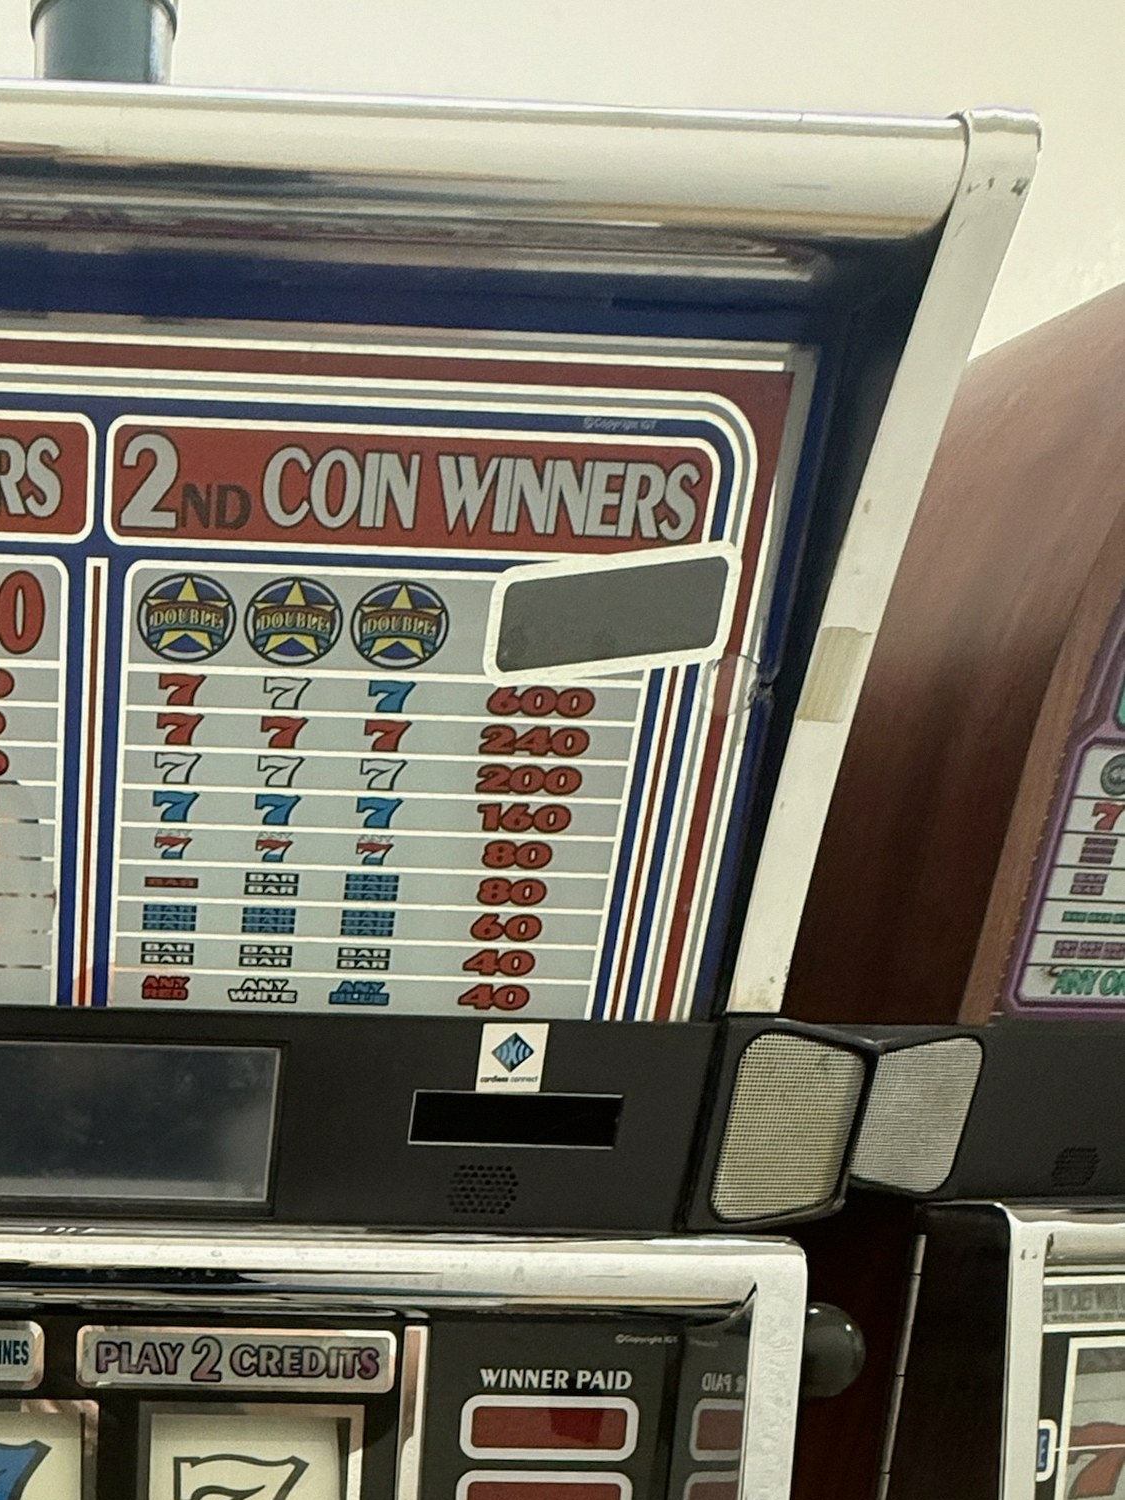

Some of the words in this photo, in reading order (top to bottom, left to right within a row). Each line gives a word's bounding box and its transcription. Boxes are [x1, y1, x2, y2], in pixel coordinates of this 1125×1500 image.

[261, 444, 421, 531] COIN
[436, 453, 701, 541] WINNERS
[153, 608, 222, 631] DOUBLE
[259, 611, 330, 633] DOUBLE
[364, 613, 435, 637] DOUBLE
[159, 673, 207, 706] 7
[264, 677, 312, 710] 7
[368, 680, 416, 713] 7
[486, 685, 596, 718] 600
[479, 725, 590, 757] 240
[475, 764, 583, 796] 200
[476, 803, 572, 833] 160
[481, 839, 553, 869] 80
[476, 877, 548, 907] 80
[470, 913, 543, 942] 60
[462, 948, 535, 977] 40
[228, 989, 297, 1004] WHITE
[241, 978, 290, 992] ANY
[457, 983, 531, 1012] 40
[95, 1342, 184, 1375] PLAY
[191, 1335, 222, 1383] 2
[230, 1344, 380, 1381] CREDITS
[480, 1369, 569, 1389] WINNER
[576, 1370, 633, 1391] PAID
